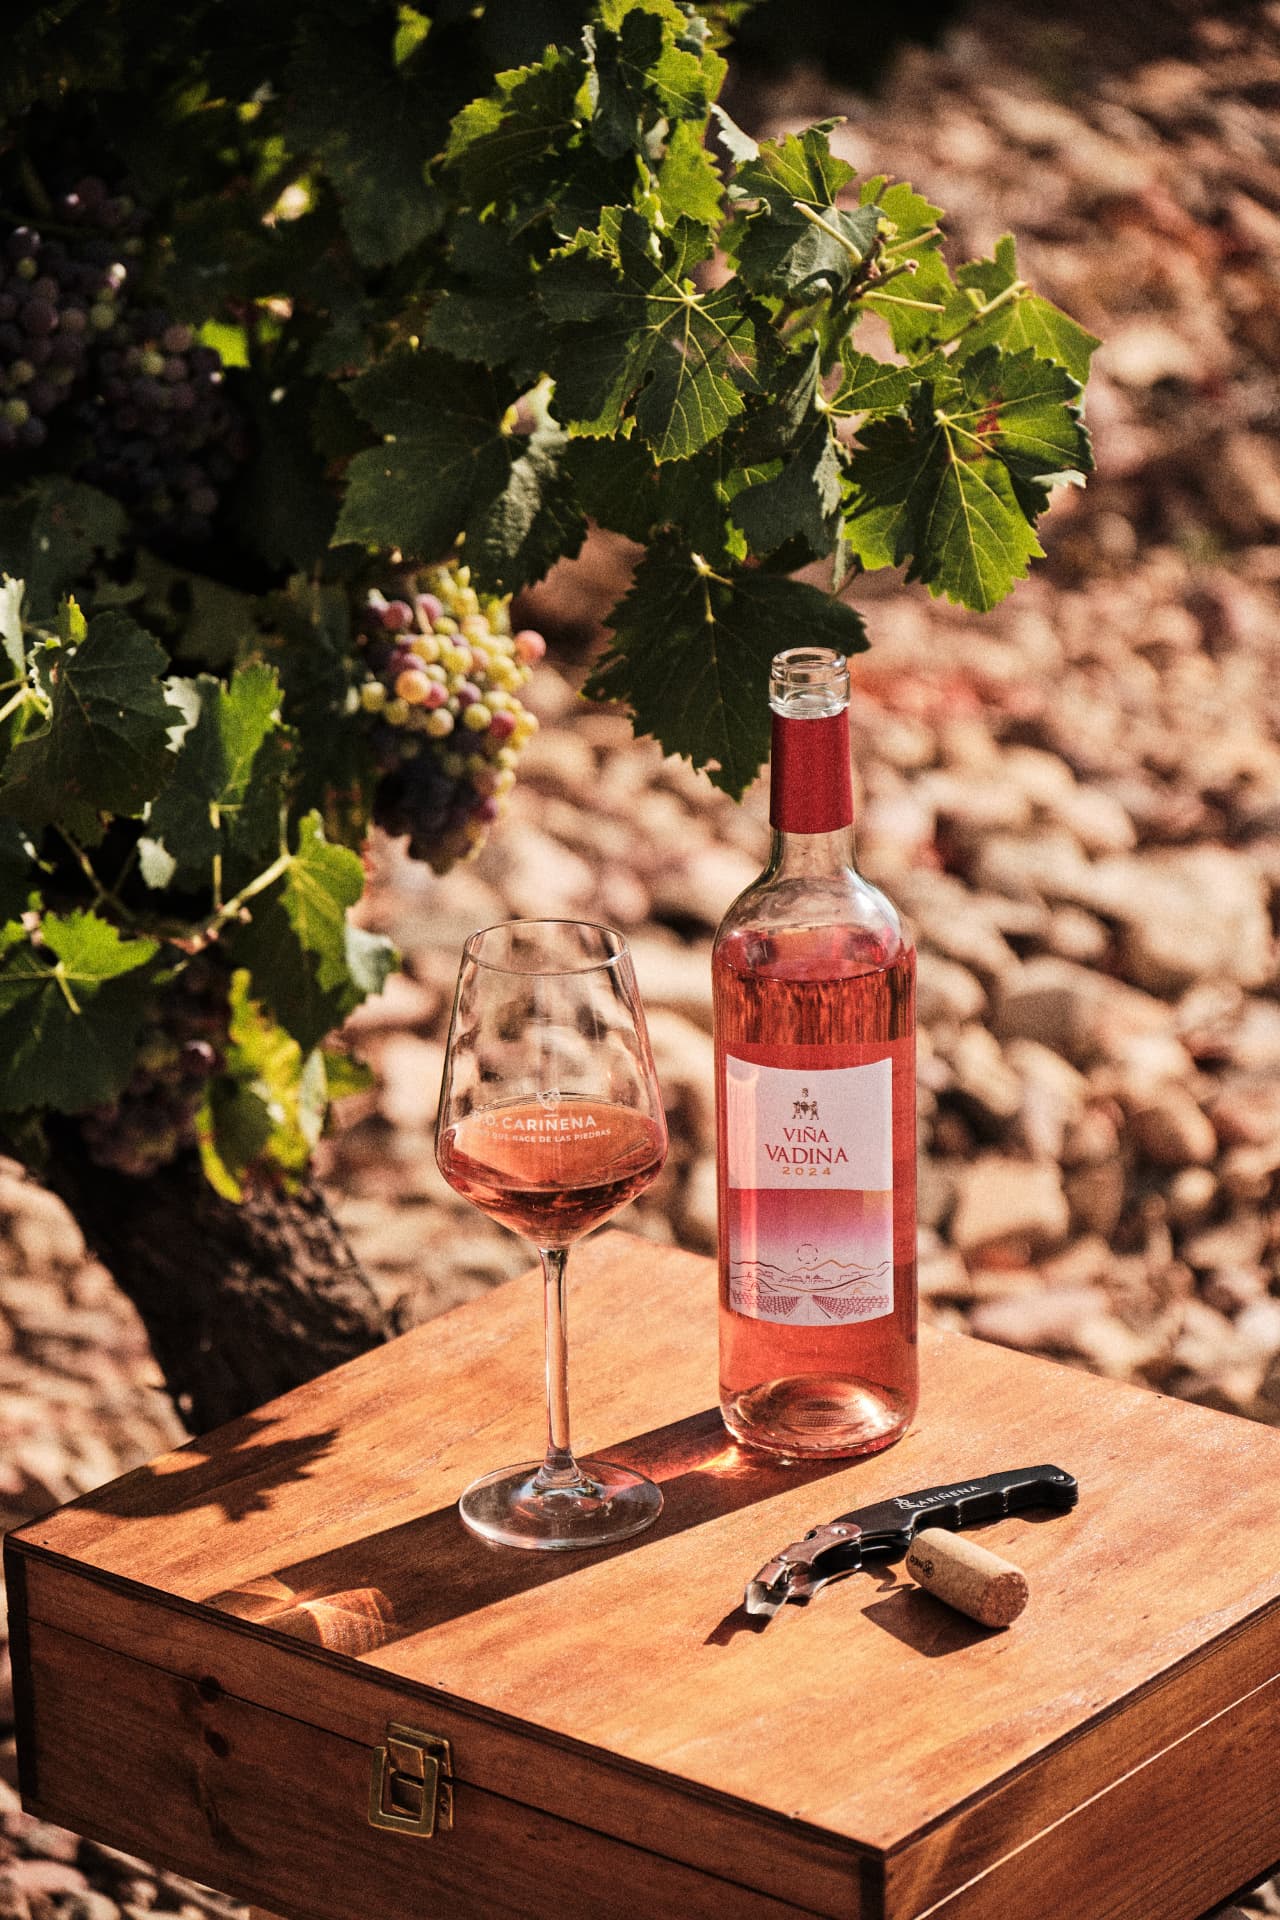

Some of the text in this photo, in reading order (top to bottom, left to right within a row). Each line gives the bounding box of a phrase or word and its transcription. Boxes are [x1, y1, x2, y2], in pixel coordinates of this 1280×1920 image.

[538, 1135, 553, 1143] DE
[554, 1134, 572, 1143] LAS
[574, 1128, 612, 1141] PIEDRAS
[782, 1126, 830, 1143] VIÑA
[765, 1143, 849, 1164] VADINA
[782, 1166, 831, 1177] 2024
